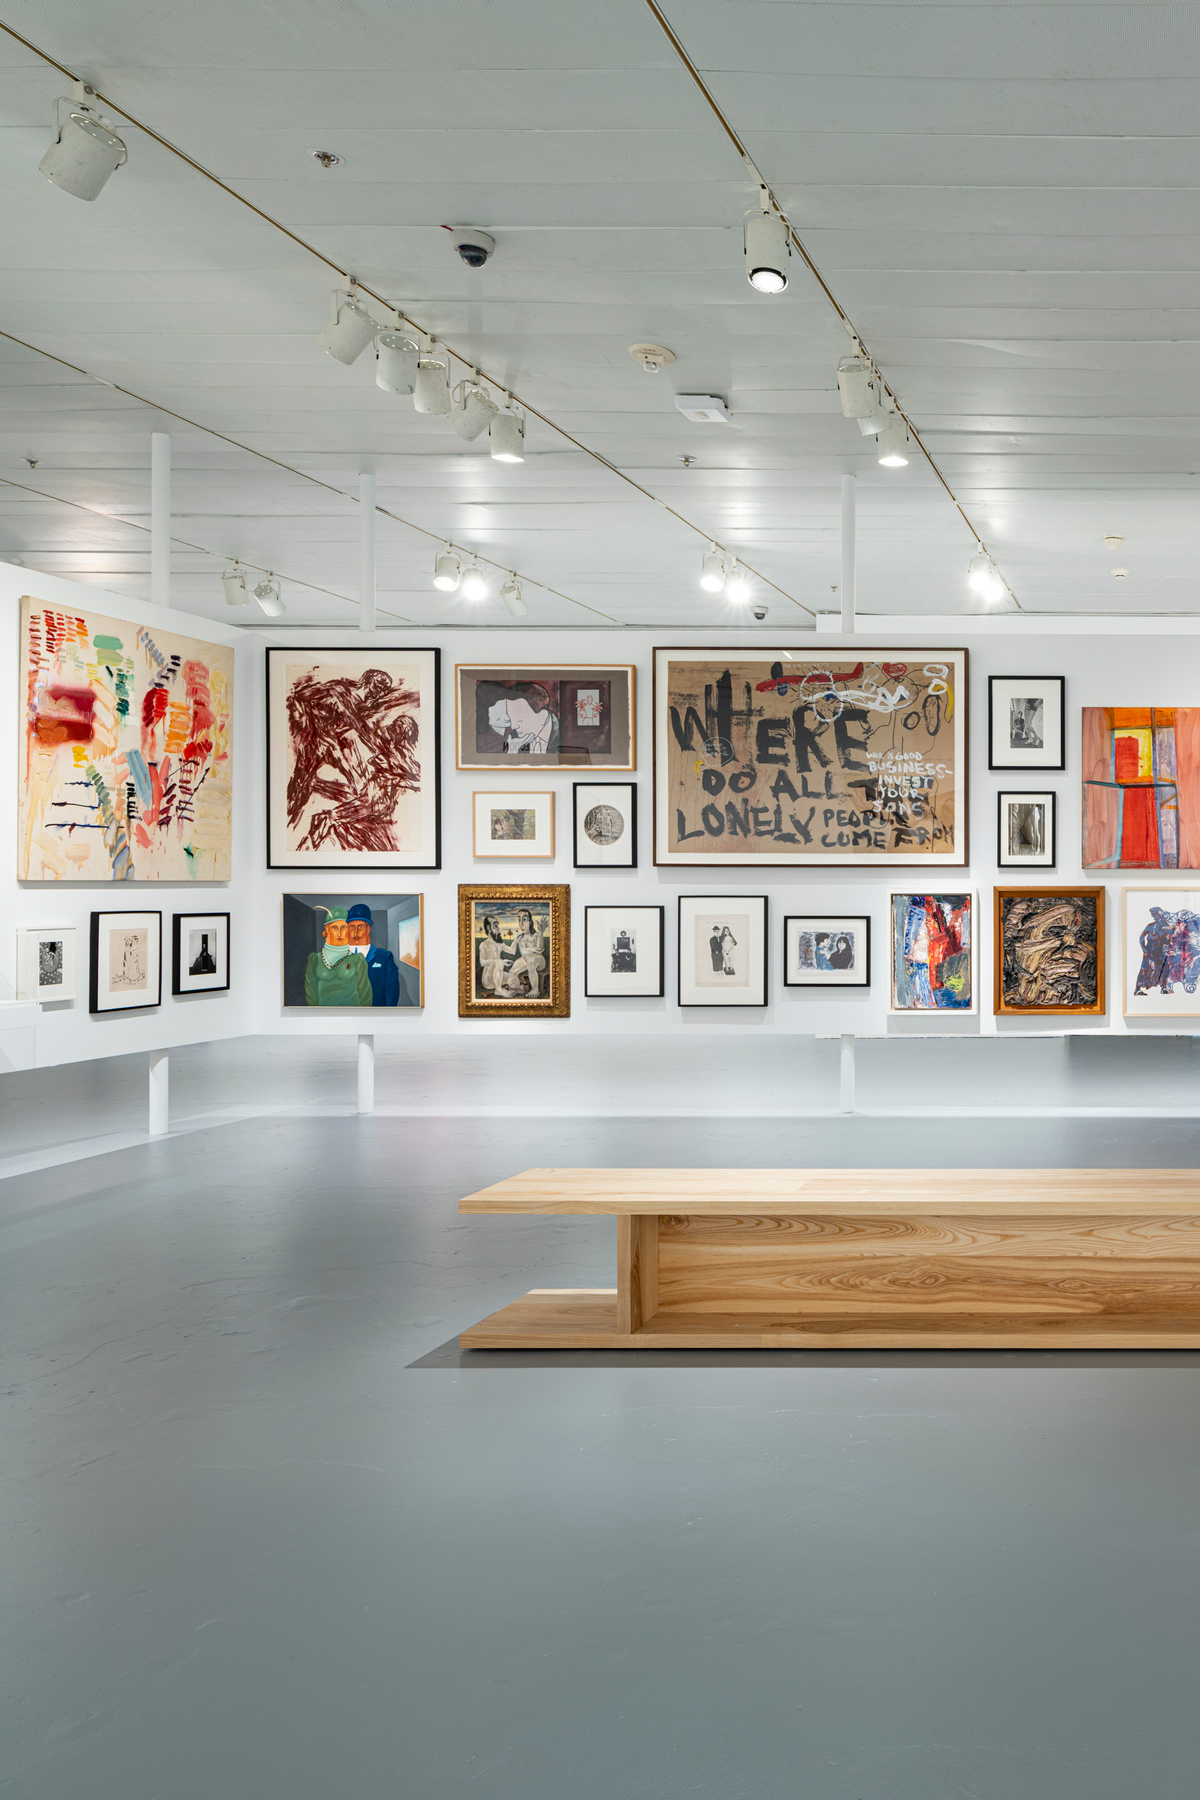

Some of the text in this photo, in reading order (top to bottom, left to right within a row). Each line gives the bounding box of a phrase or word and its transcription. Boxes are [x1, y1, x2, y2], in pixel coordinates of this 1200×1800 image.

[669, 668, 872, 773] WHERE
[895, 751, 923, 761] GOOD
[702, 768, 757, 796] DO
[769, 769, 851, 803] ALL
[879, 774, 933, 789] INVEST
[880, 785, 925, 800] YOUR
[676, 797, 816, 845] LONELY
[872, 799, 924, 820] SONS
[892, 821, 954, 849] FROM
